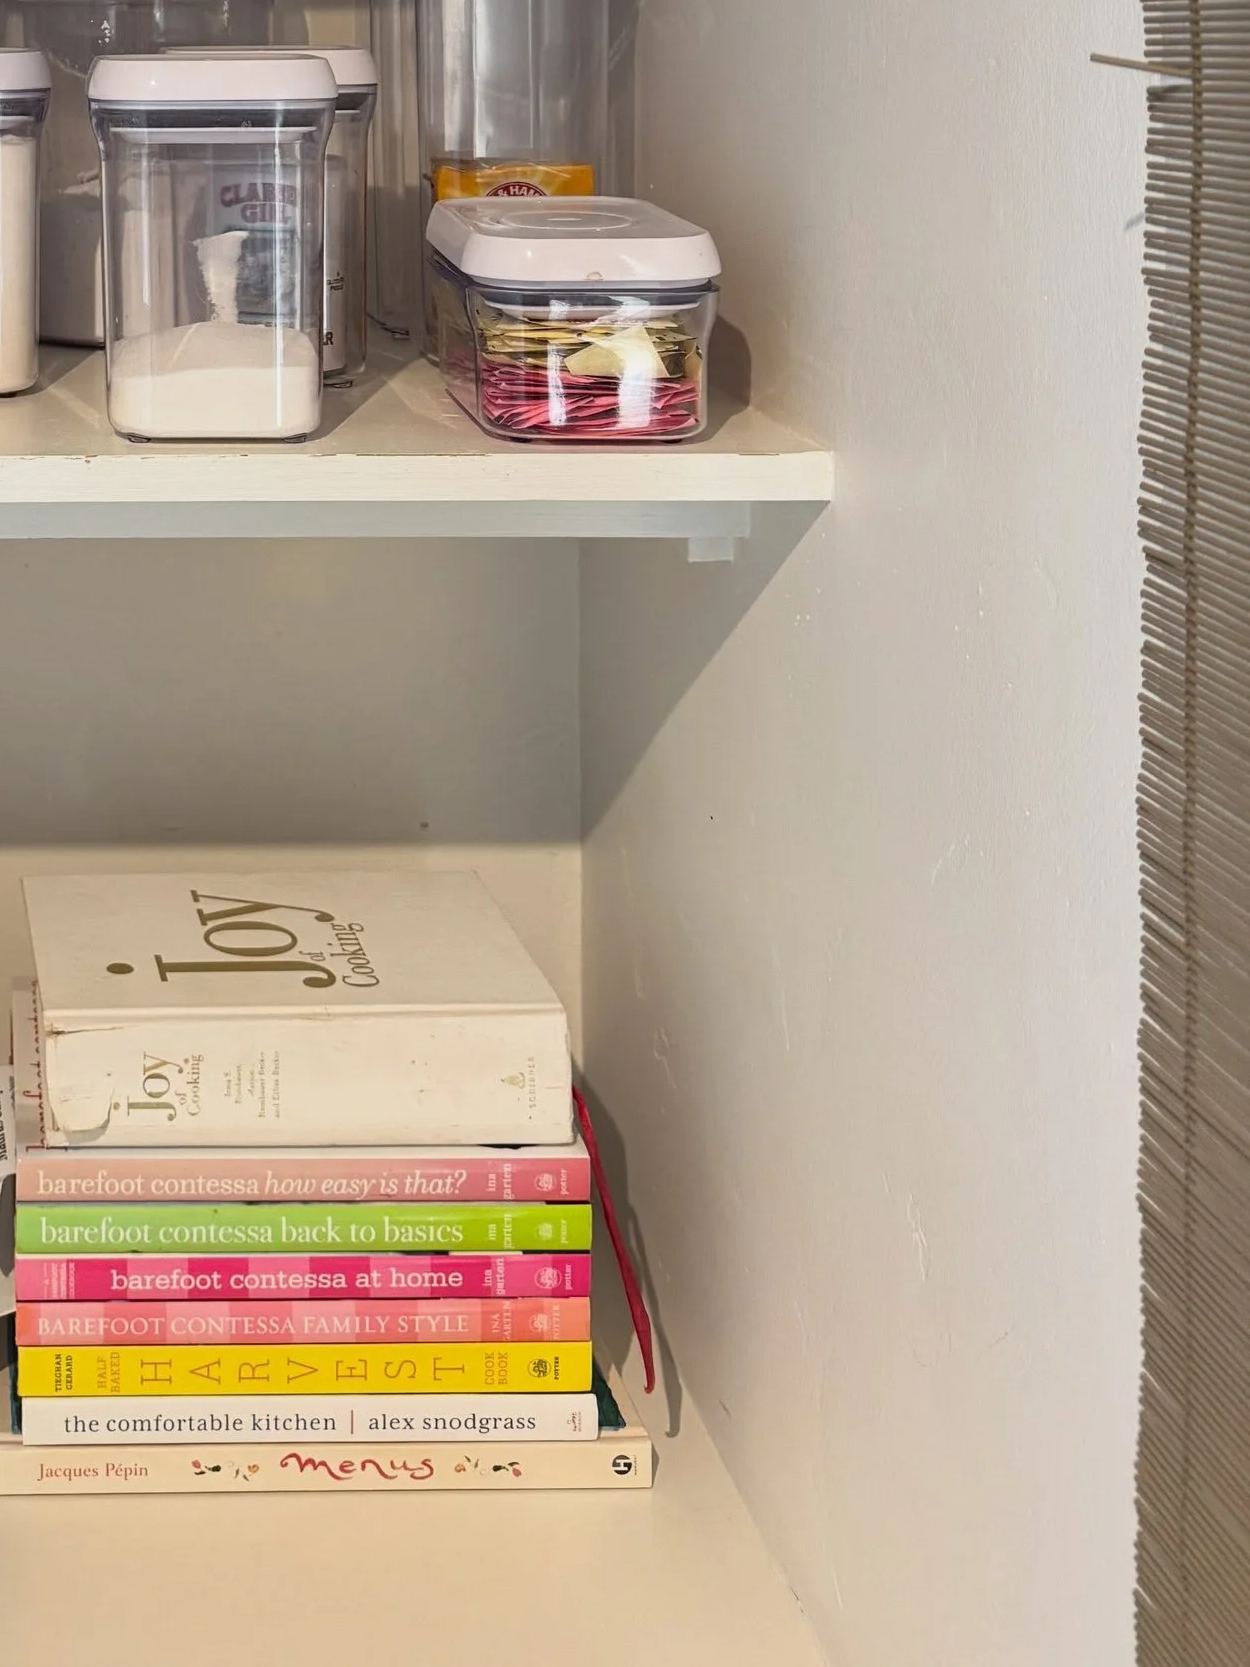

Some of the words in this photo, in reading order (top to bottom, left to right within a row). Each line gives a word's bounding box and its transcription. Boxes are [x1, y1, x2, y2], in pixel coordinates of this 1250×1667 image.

[298, 950, 326, 963] of
[330, 922, 380, 988] Cooking
[175, 1091, 187, 1106] of
[186, 1053, 205, 1117] Cooking
[37, 1170, 145, 1195] barefoot
[151, 1173, 259, 1195] contessa
[264, 1171, 317, 1195] how
[321, 1177, 376, 1200] easy
[379, 1170, 399, 1194] is
[403, 1169, 467, 1195] that?
[486, 1173, 496, 1192] ina
[503, 1163, 515, 1200] garten
[560, 1168, 569, 1195] potter
[40, 1216, 151, 1244] barefoot
[158, 1221, 273, 1244] contessa
[279, 1216, 340, 1243] back
[349, 1220, 376, 1242] to
[383, 1215, 463, 1243] basics
[111, 1269, 221, 1291] barefoot
[230, 1271, 347, 1290] contessa
[355, 1270, 382, 1288] at
[389, 1268, 464, 1288] home
[482, 1269, 493, 1287] ina
[495, 1257, 505, 1295] garten
[565, 1263, 573, 1291] potter
[37, 1317, 165, 1335] BAREFOOT
[171, 1316, 295, 1335] CONTESSA
[303, 1315, 389, 1334] FAMILY
[396, 1315, 469, 1333] STYLE
[491, 1313, 500, 1333] INA
[65, 1355, 73, 1390] GERARD
[97, 1356, 107, 1389] HALF
[110, 1351, 121, 1393] BAKED
[485, 1352, 495, 1385] COOK
[498, 1351, 508, 1385] BOOK
[63, 1414, 100, 1433] the
[106, 1413, 244, 1433] comfortable
[251, 1413, 337, 1432] kitchen
[368, 1413, 415, 1431] alex
[422, 1413, 537, 1435] snodgrass
[37, 1462, 99, 1482] Jacques
[105, 1460, 149, 1481] Pépin
